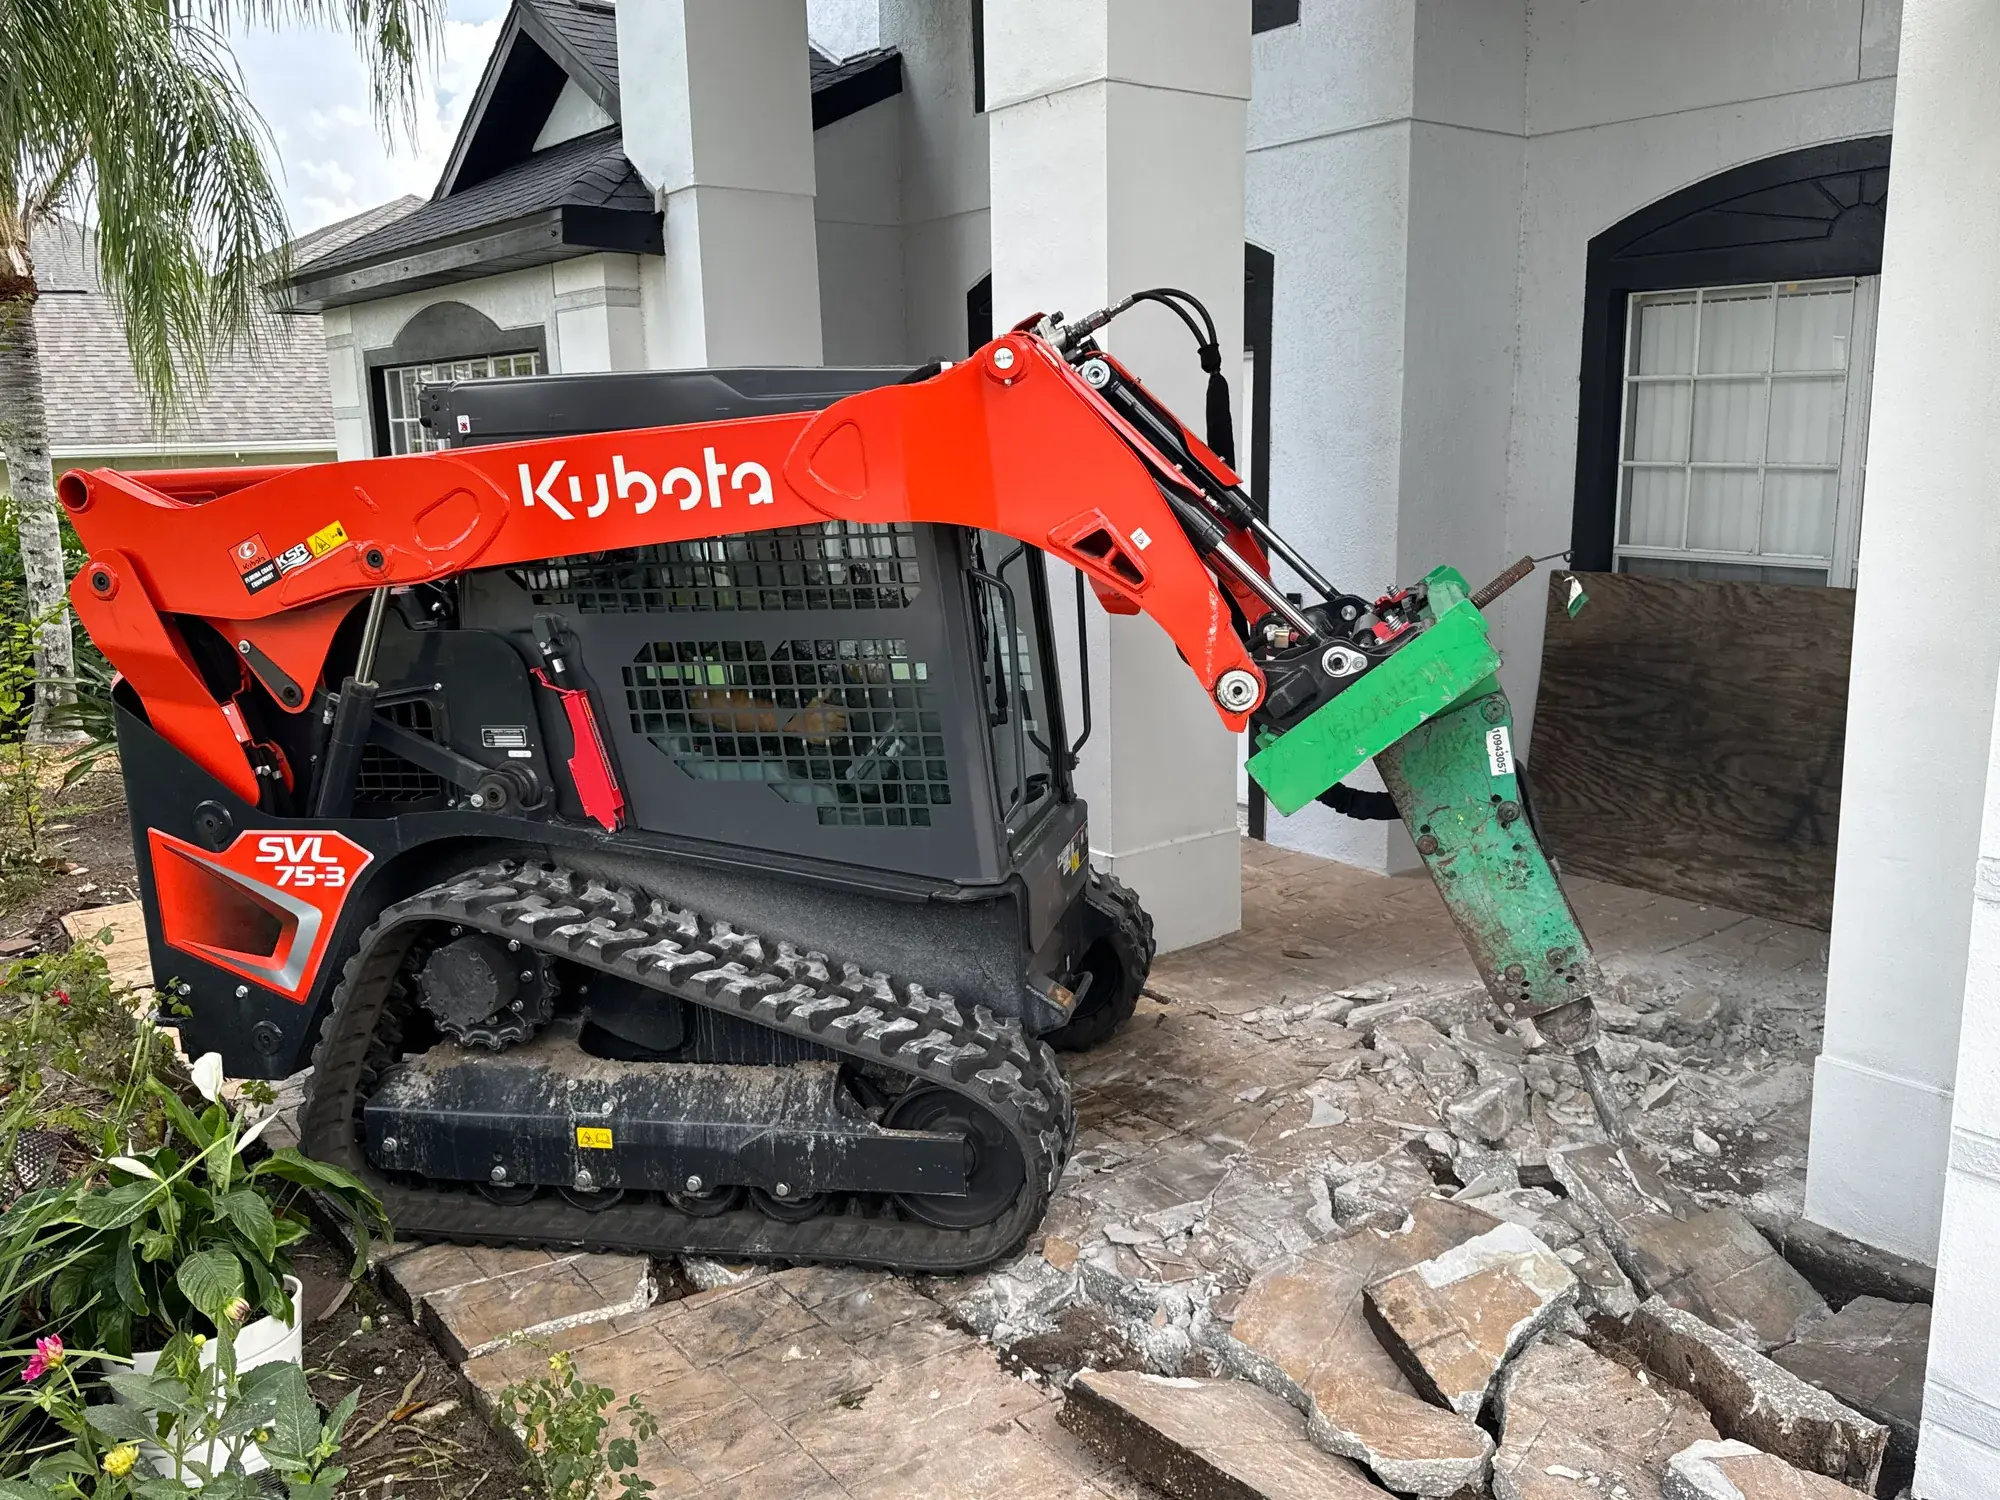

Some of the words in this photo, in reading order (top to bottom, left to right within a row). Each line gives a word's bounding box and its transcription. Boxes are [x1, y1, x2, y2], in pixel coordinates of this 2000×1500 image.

[518, 447, 774, 520] Kubota
[275, 543, 309, 567] KSR
[1492, 728, 1507, 774] 10943057
[255, 837, 338, 863] SVL
[274, 866, 346, 887] 75-3
